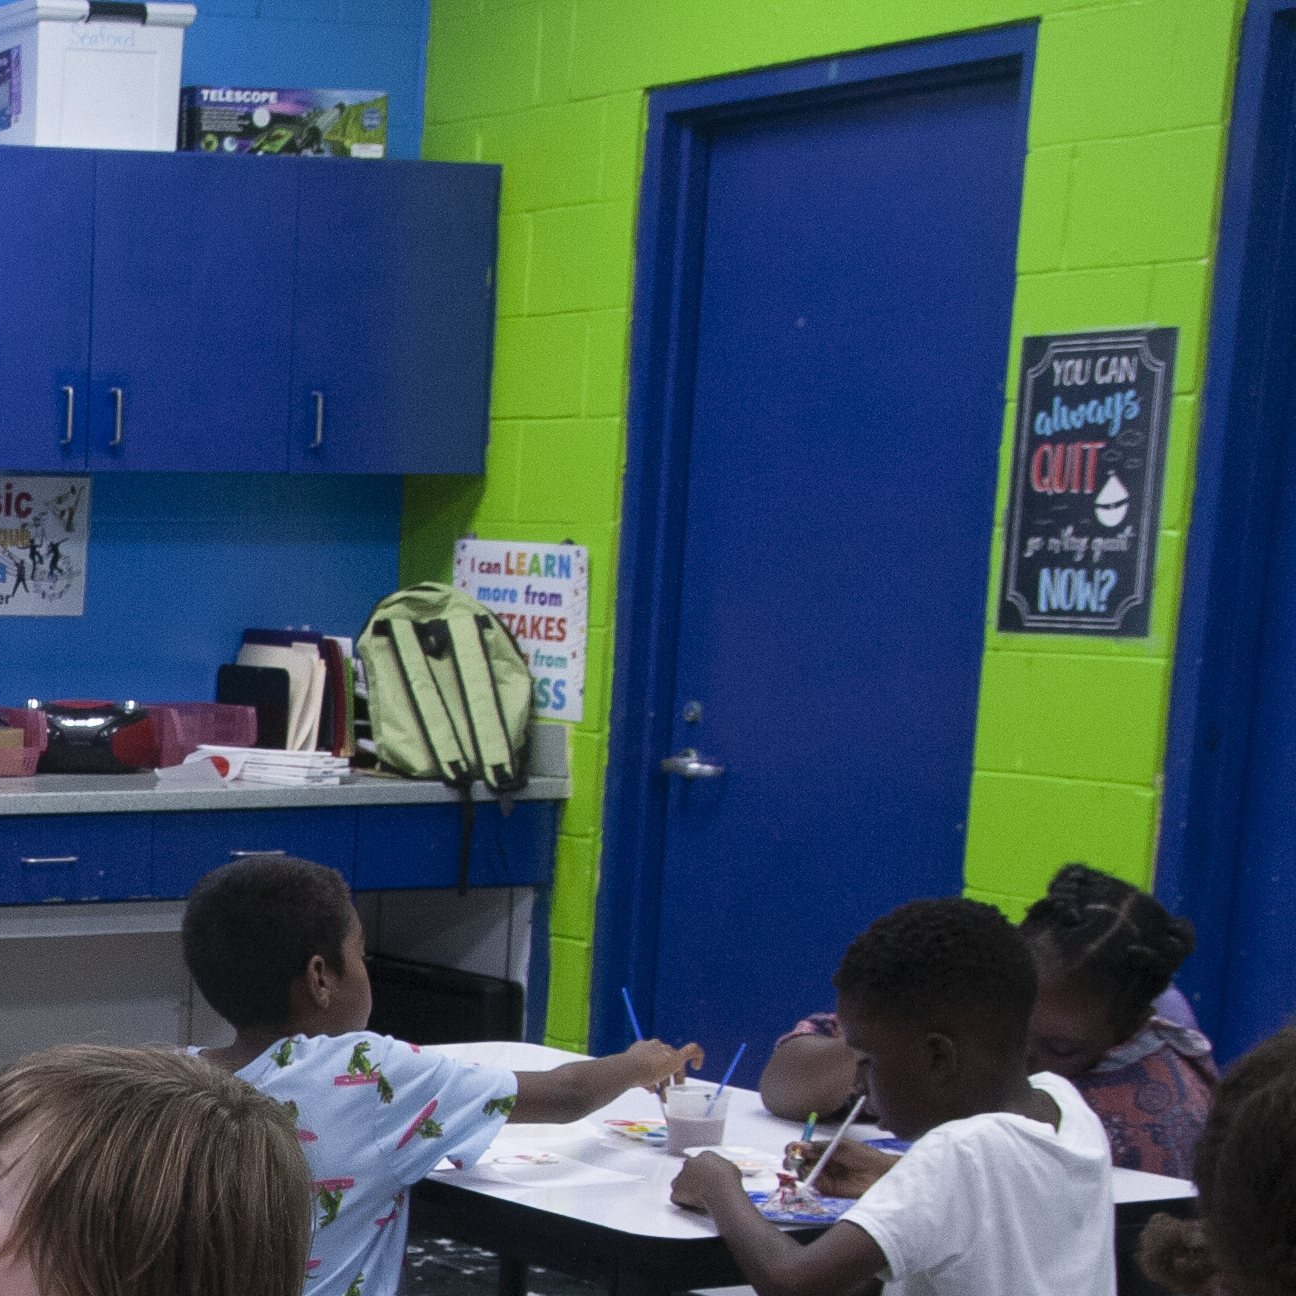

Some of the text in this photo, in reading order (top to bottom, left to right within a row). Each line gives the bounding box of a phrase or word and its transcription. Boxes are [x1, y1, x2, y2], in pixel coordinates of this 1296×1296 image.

[200, 88, 278, 104] TELESCOPE
[1052, 355, 1139, 387] YOU CAN
[1034, 388, 1142, 438] always
[1030, 440, 1106, 495] QUIT
[470, 551, 572, 579] I can LEARN
[477, 584, 563, 607] more from
[1037, 567, 1118, 613] NOW?
[498, 612, 568, 643] TAKES
[533, 648, 568, 669] from
